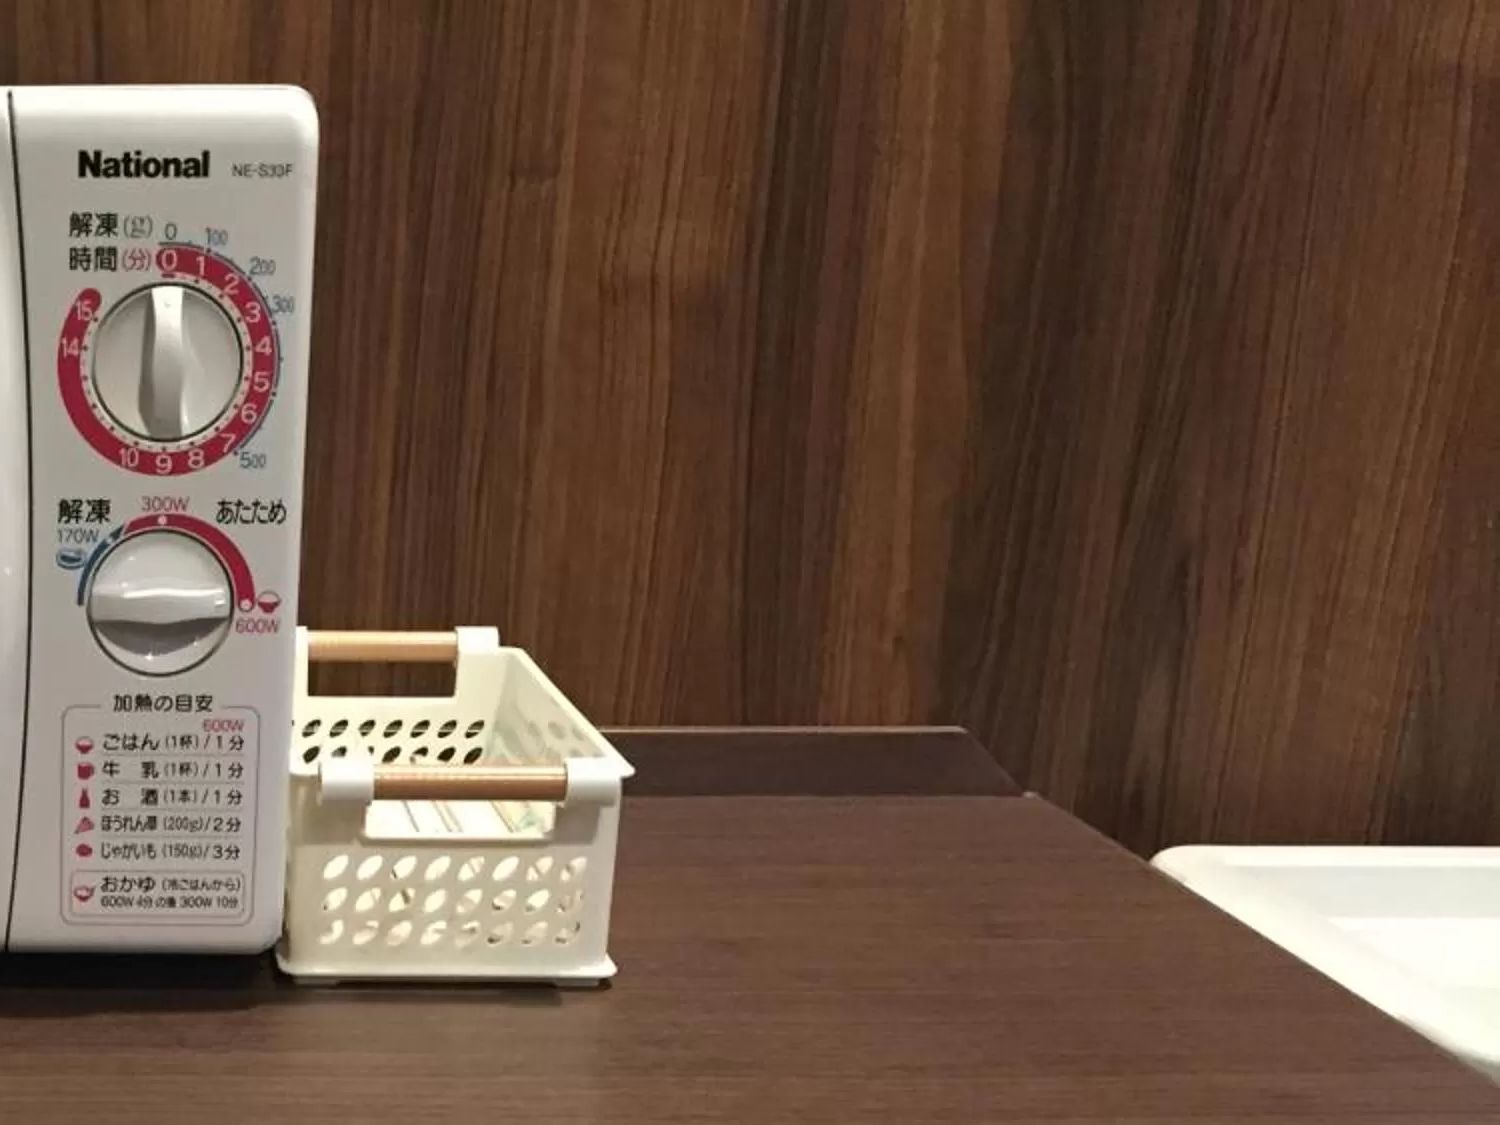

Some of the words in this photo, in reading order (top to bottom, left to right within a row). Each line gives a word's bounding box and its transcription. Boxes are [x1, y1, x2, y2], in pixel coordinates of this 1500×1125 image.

[78, 150, 210, 178] National
[164, 223, 178, 240] 0
[205, 227, 229, 246] 100
[161, 250, 178, 271] 0
[196, 256, 206, 276] 1
[250, 257, 276, 275] 200
[224, 273, 240, 296] 2
[76, 301, 93, 322] 15
[244, 302, 261, 323] 3
[272, 296, 295, 313] 300
[61, 338, 79, 359] 14
[255, 336, 272, 356] 4
[253, 372, 269, 393] 5
[240, 404, 257, 424] 6
[219, 434, 236, 454] 7
[119, 449, 140, 468] 10
[155, 455, 173, 475] 9
[187, 450, 205, 469] 8
[239, 453, 267, 470] 500
[57, 498, 111, 524] 解凍
[141, 496, 191, 512] 300W
[216, 499, 287, 525] あたため
[57, 528, 99, 544] 170W
[235, 618, 281, 633] 600W
[112, 694, 213, 712] 加熱の目安
[202, 718, 245, 732] 600W
